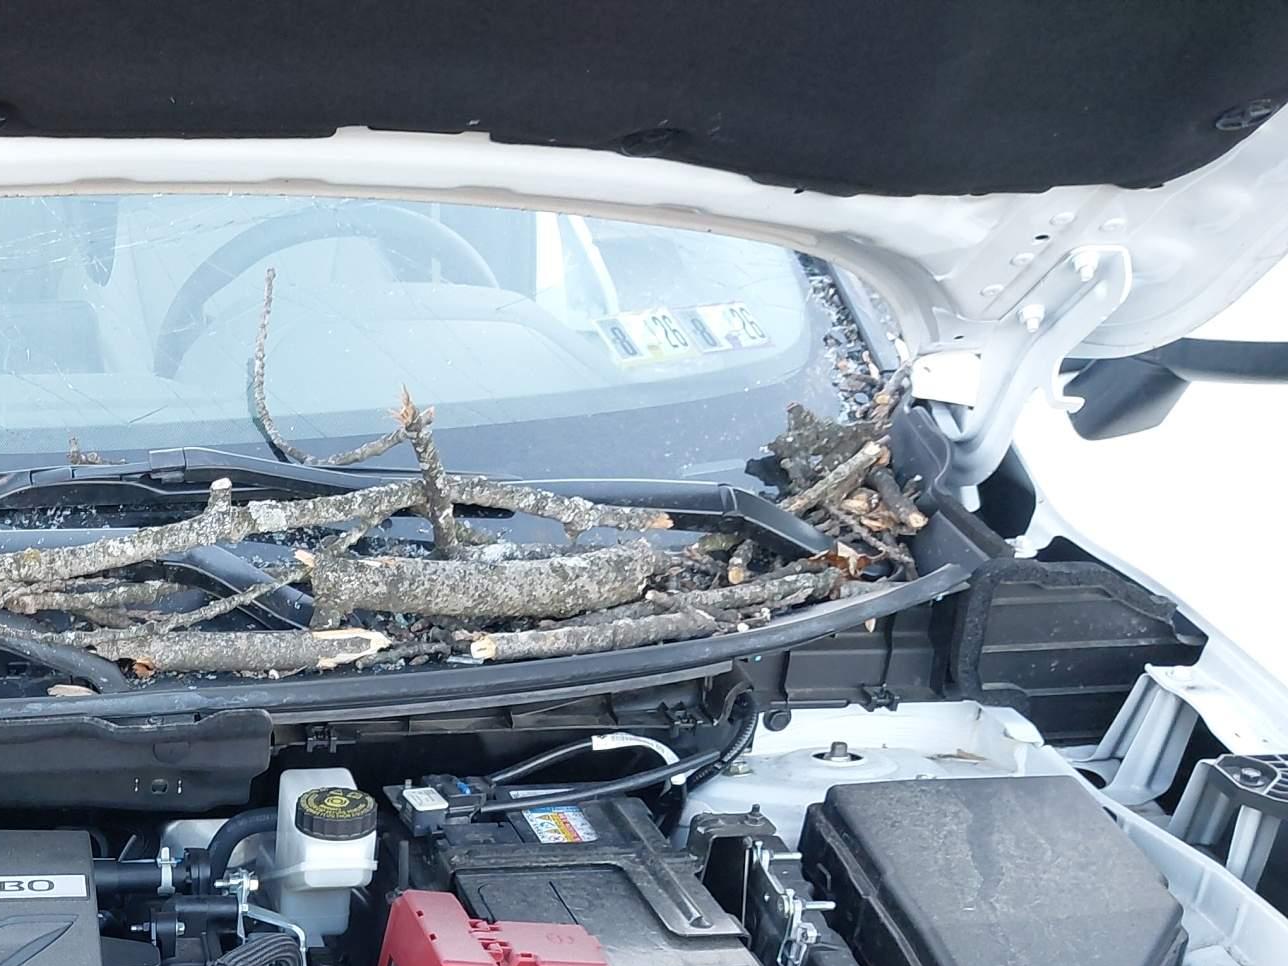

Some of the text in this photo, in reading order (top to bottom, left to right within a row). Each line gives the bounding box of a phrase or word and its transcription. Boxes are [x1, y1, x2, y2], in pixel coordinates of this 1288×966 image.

[652, 315, 688, 348] 26
[691, 307, 765, 347] 8 26
